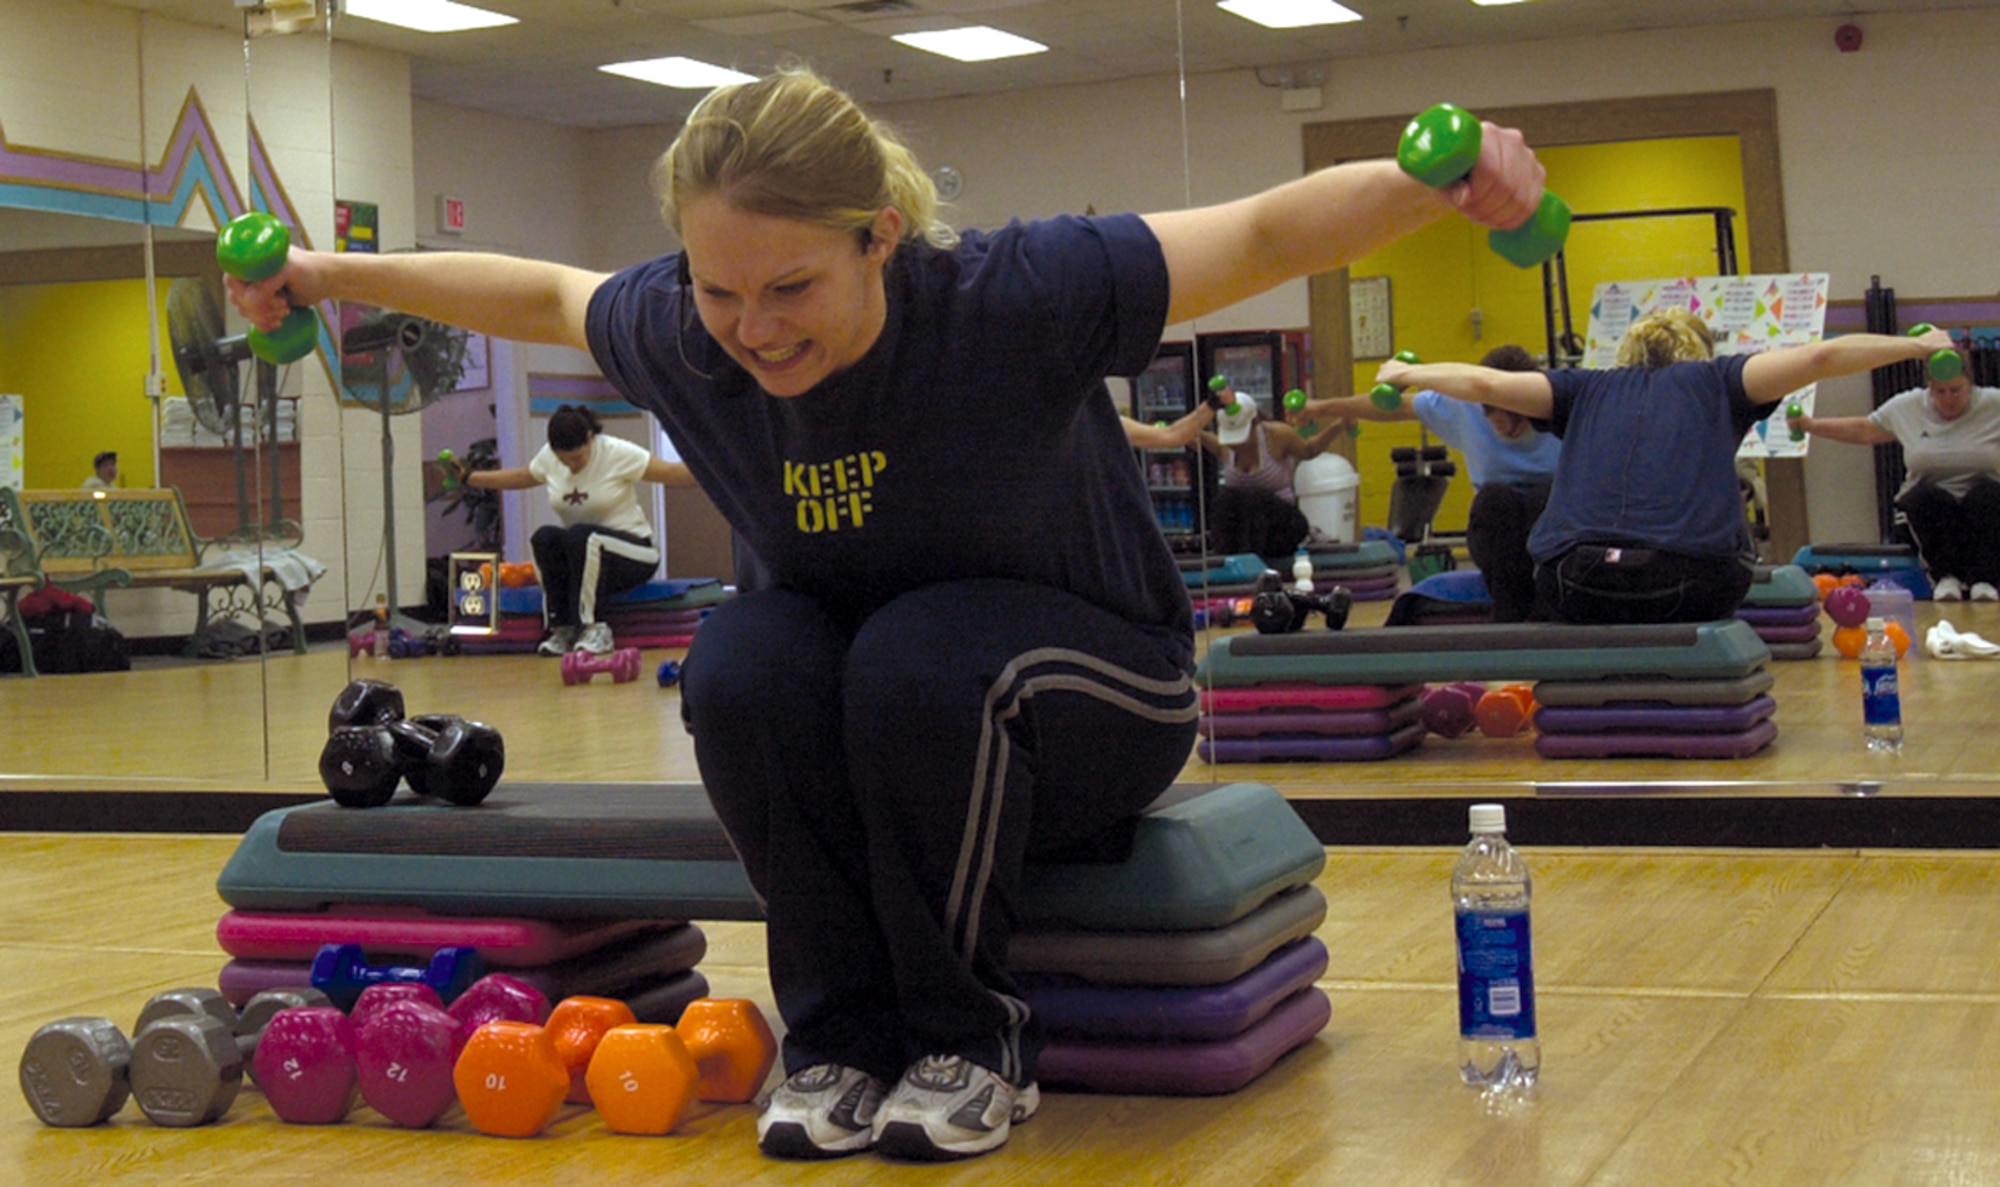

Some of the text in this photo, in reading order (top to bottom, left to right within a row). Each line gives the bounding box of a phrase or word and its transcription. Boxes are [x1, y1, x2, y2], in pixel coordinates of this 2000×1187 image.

[784, 450, 887, 497] KEEP
[797, 491, 873, 532] OFF
[283, 1057, 304, 1081] 12
[386, 1061, 409, 1083] 12
[485, 1073, 507, 1092] 10
[618, 1070, 639, 1092] 10
